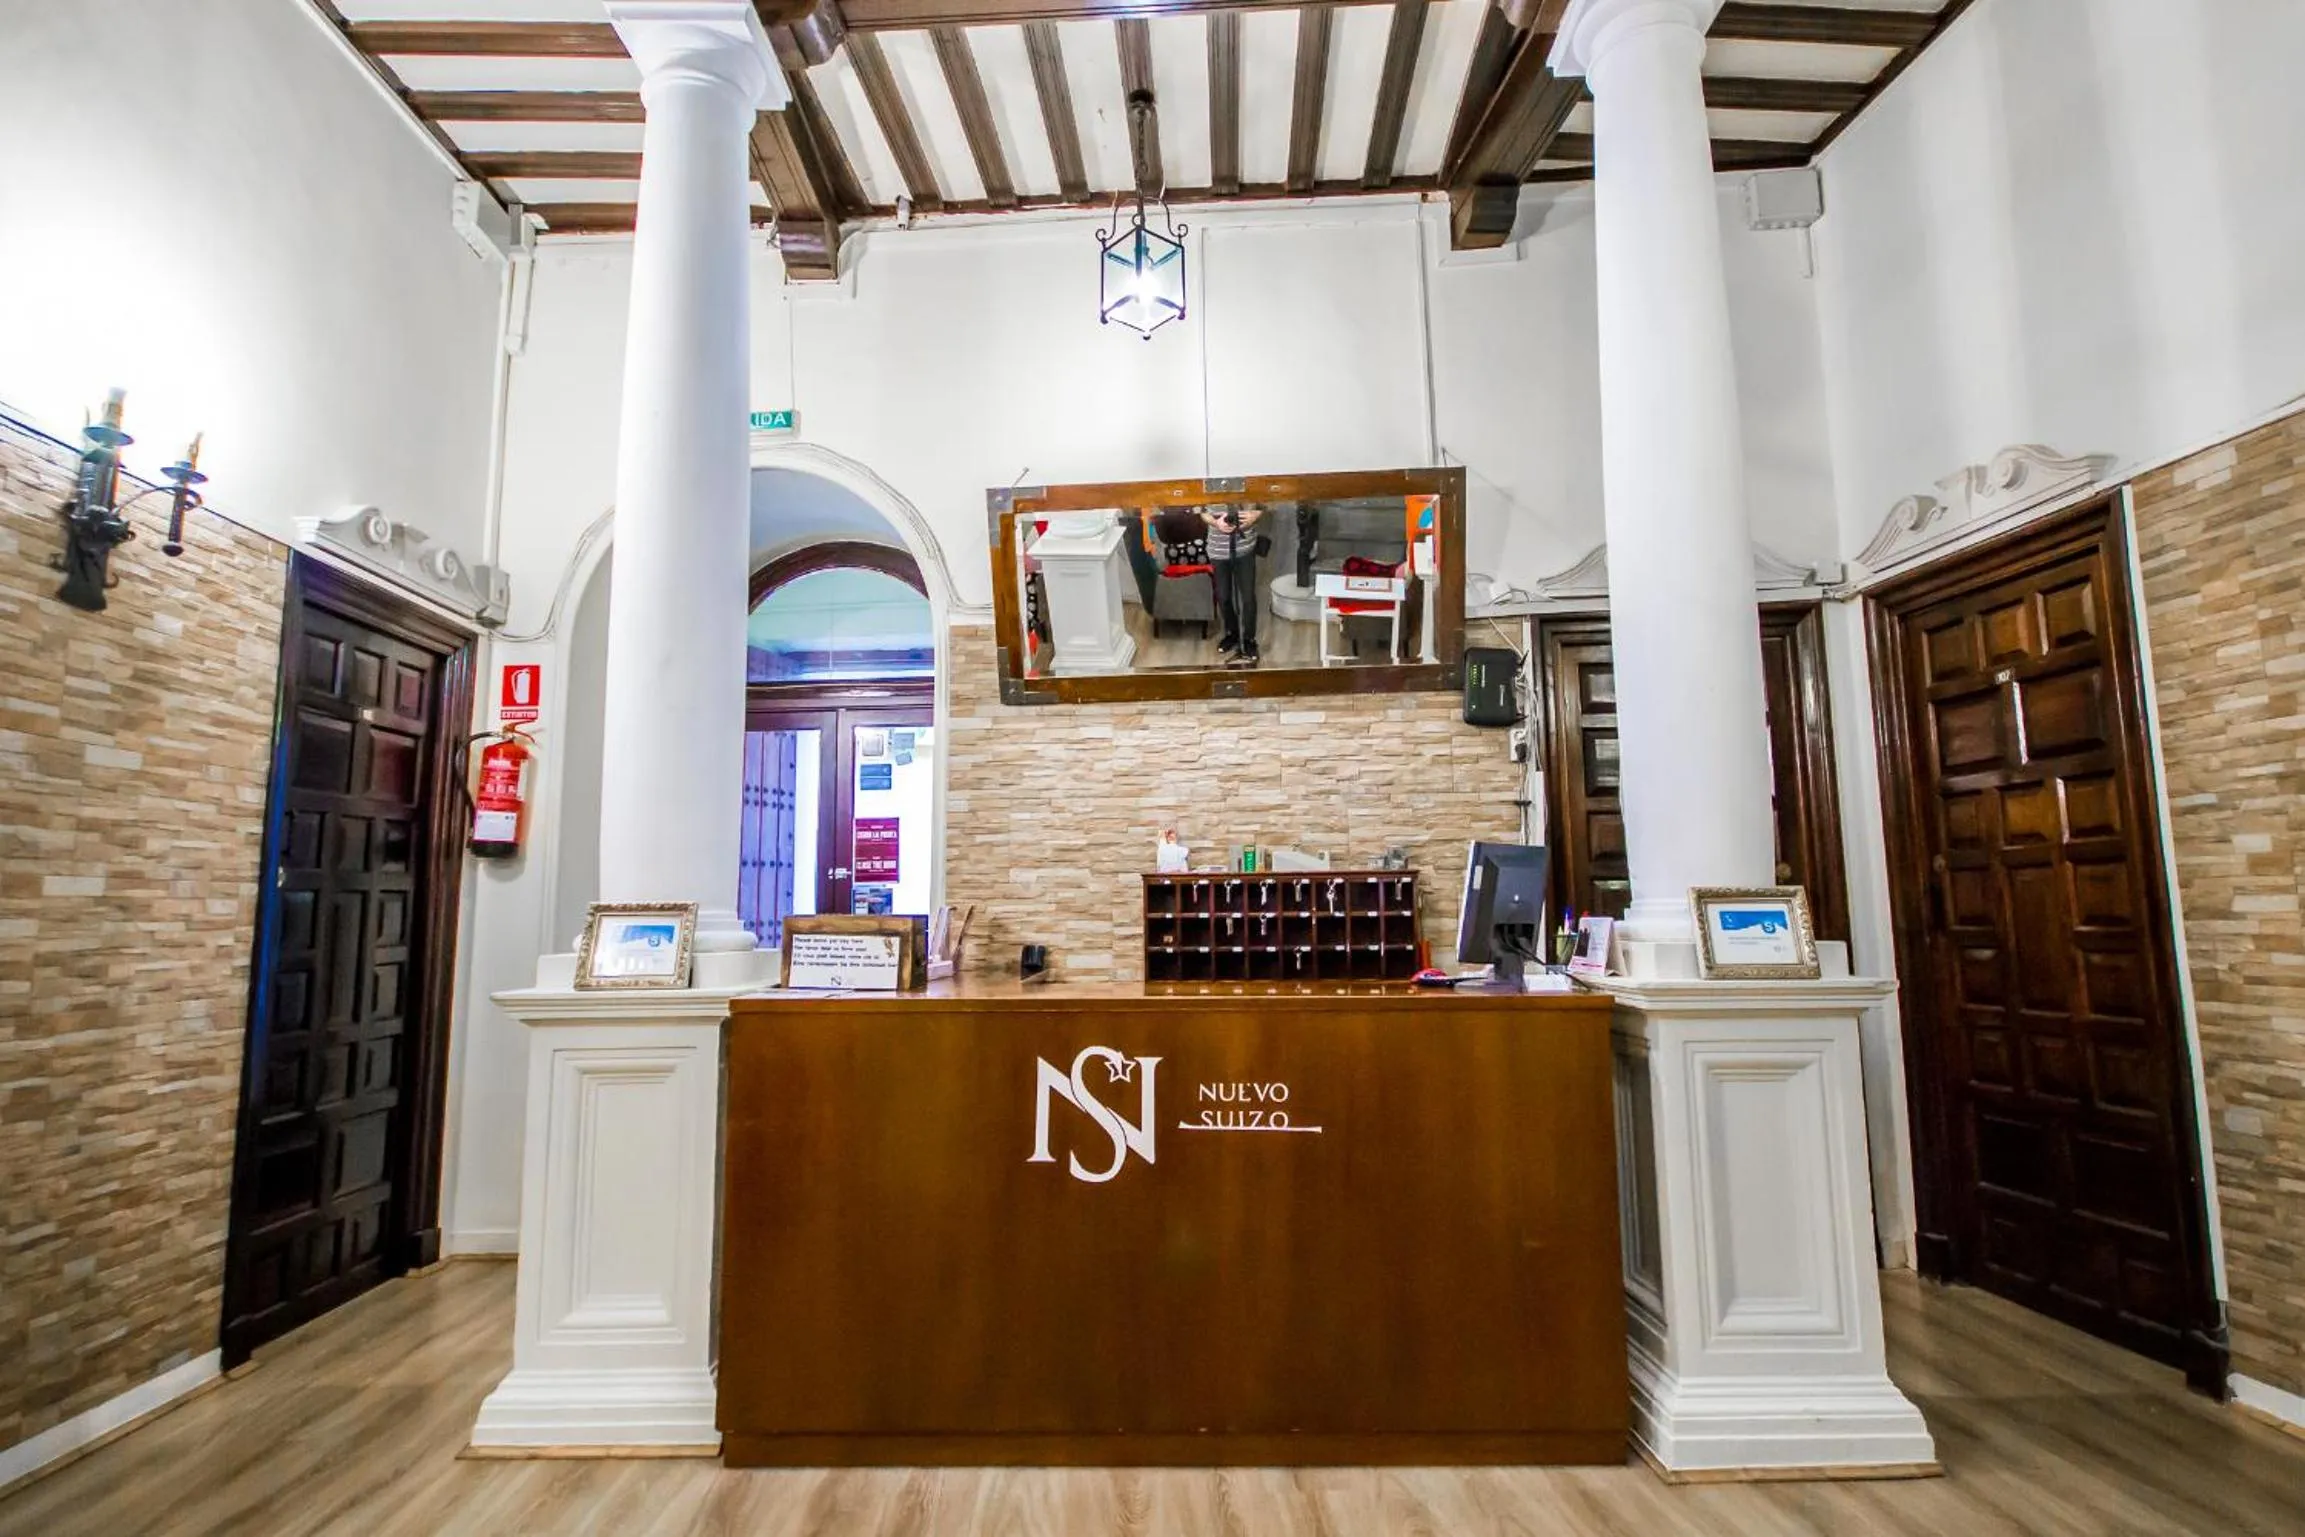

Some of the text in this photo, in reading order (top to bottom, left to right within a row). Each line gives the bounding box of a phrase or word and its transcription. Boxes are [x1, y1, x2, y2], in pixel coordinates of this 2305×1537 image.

[755, 412, 787, 426] IDA
[1199, 1082, 1290, 1103] NUEVO
[1200, 1110, 1290, 1130] SUIZO
